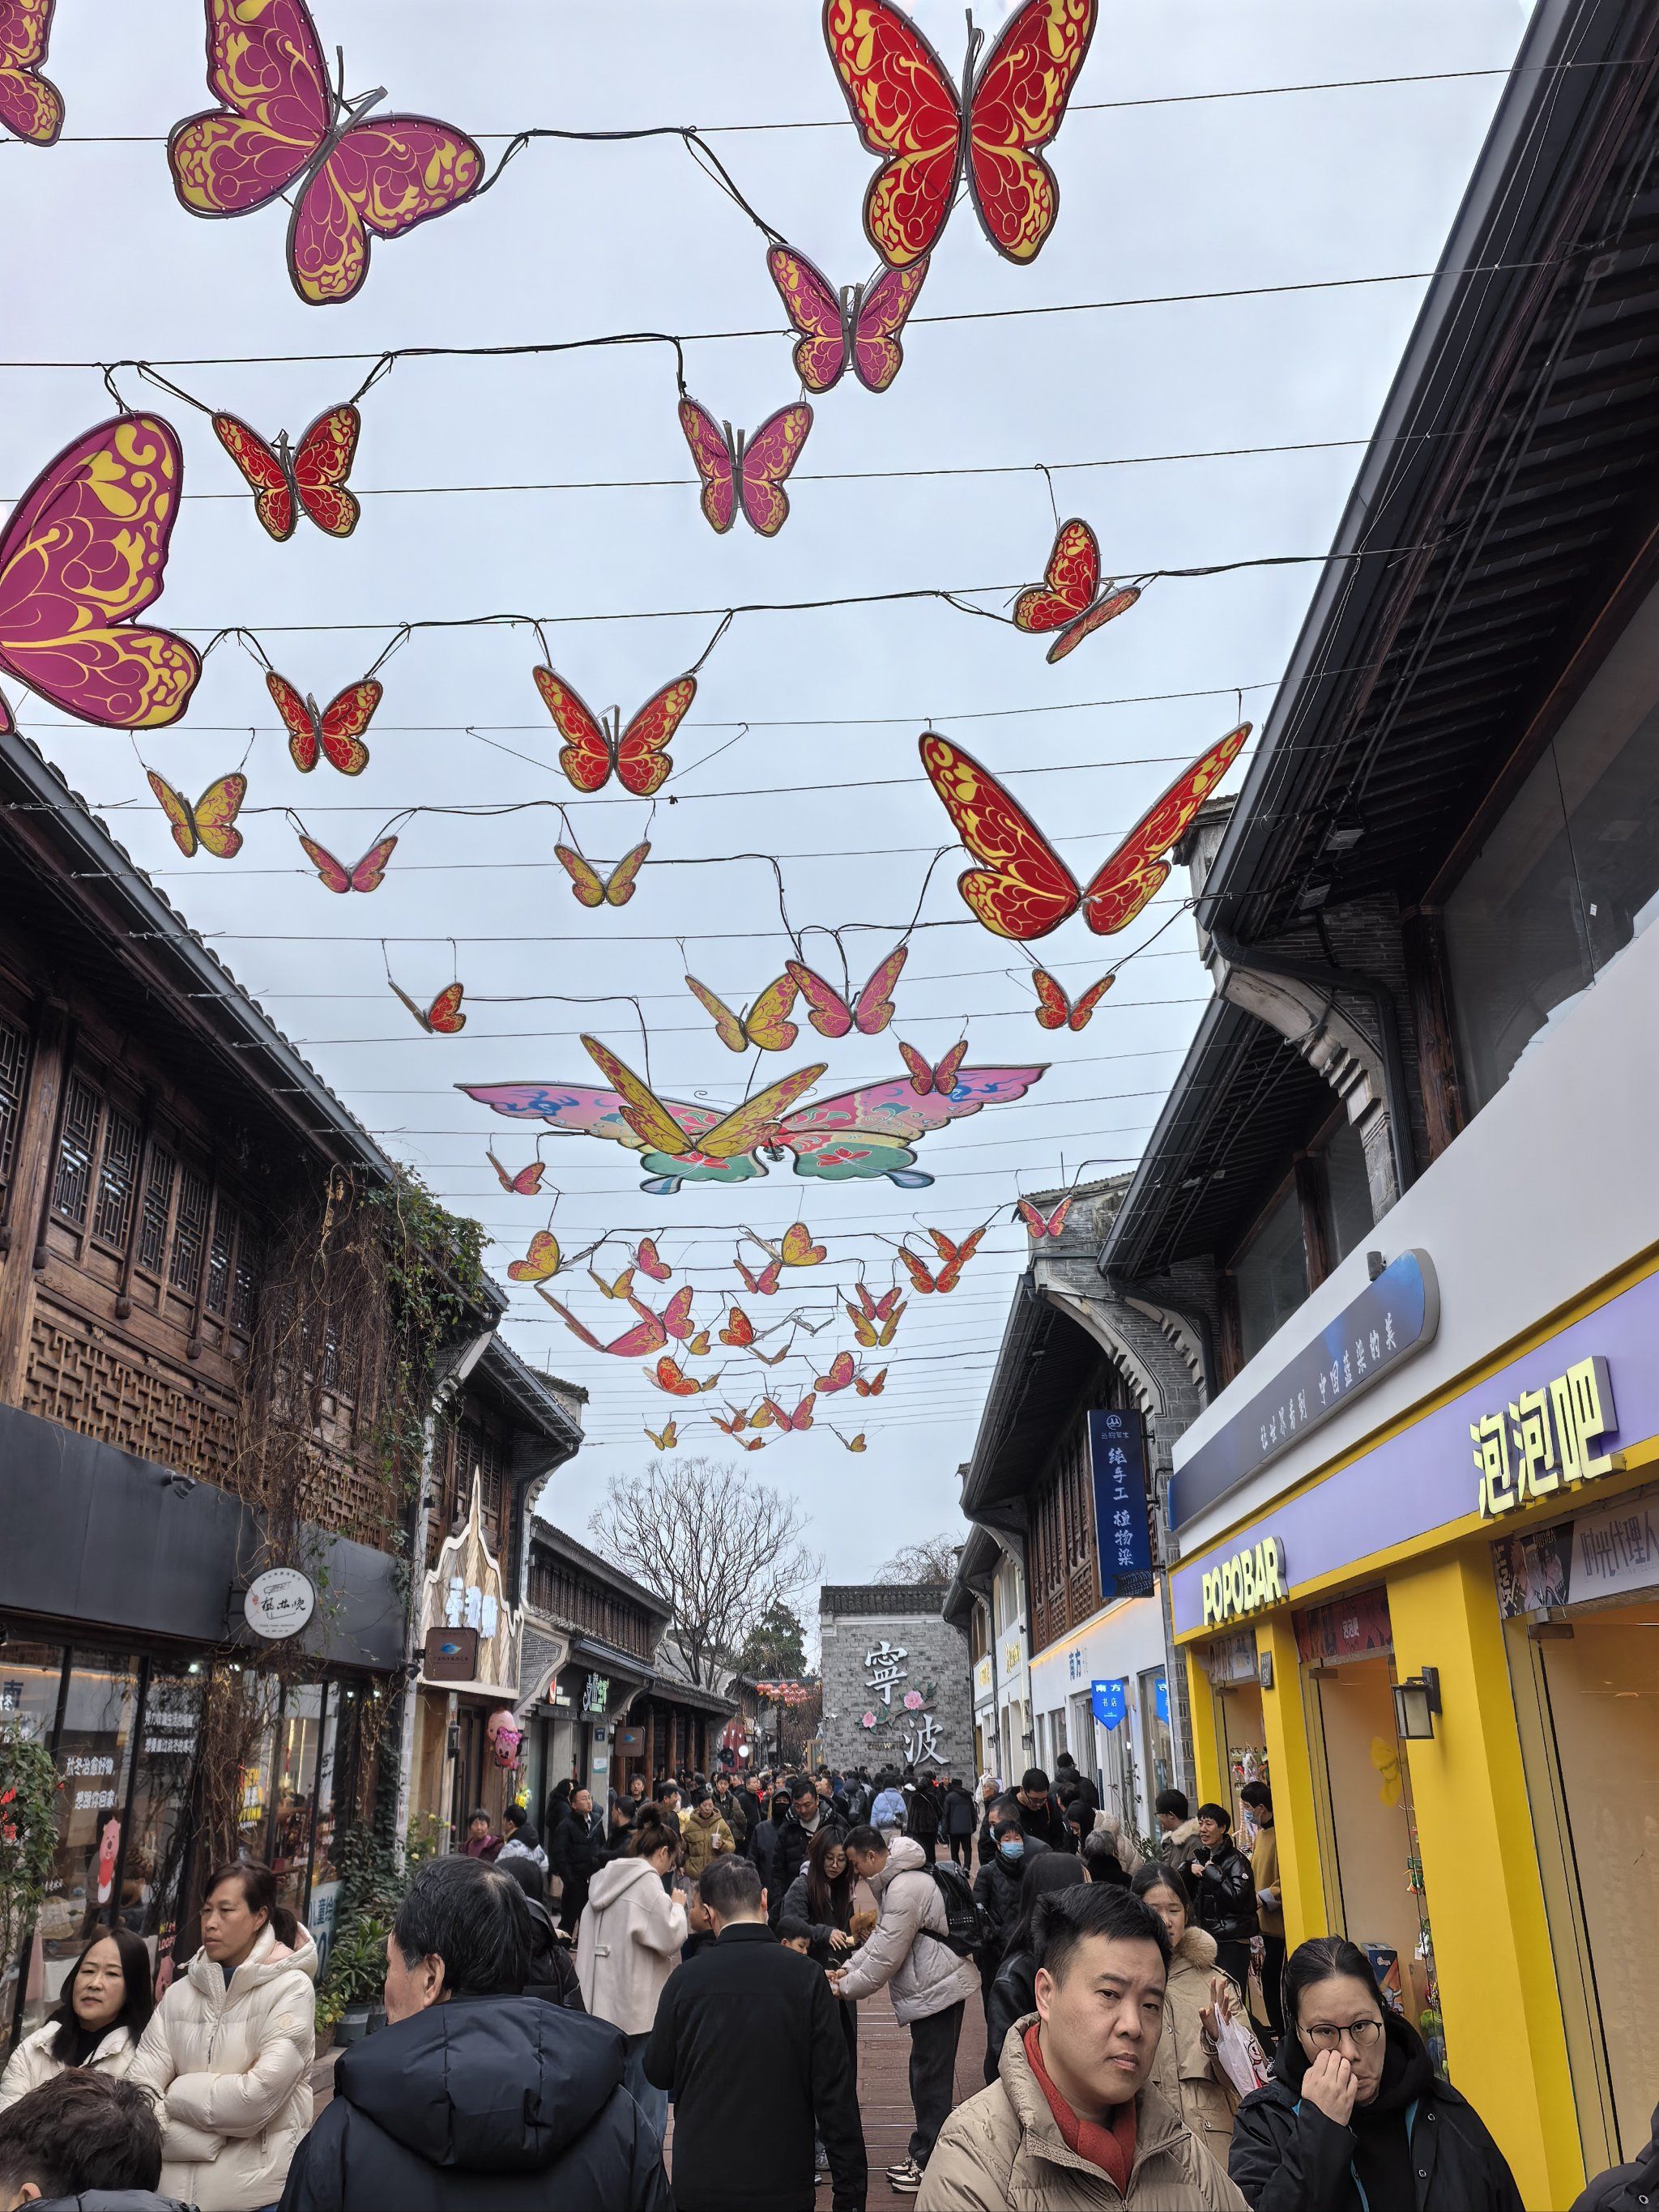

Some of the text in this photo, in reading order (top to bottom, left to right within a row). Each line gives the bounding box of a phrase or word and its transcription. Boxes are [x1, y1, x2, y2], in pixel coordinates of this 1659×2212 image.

[1469, 1355, 1613, 1519] 泡泡吧
[1107, 1447, 1134, 1566] 纯手工 植物染
[1580, 1511, 1659, 1579] 时光代理人
[1201, 1536, 1282, 1626] POPOBAR
[1095, 1684, 1121, 1693] 南方
[1102, 1697, 1117, 1707] 书店
